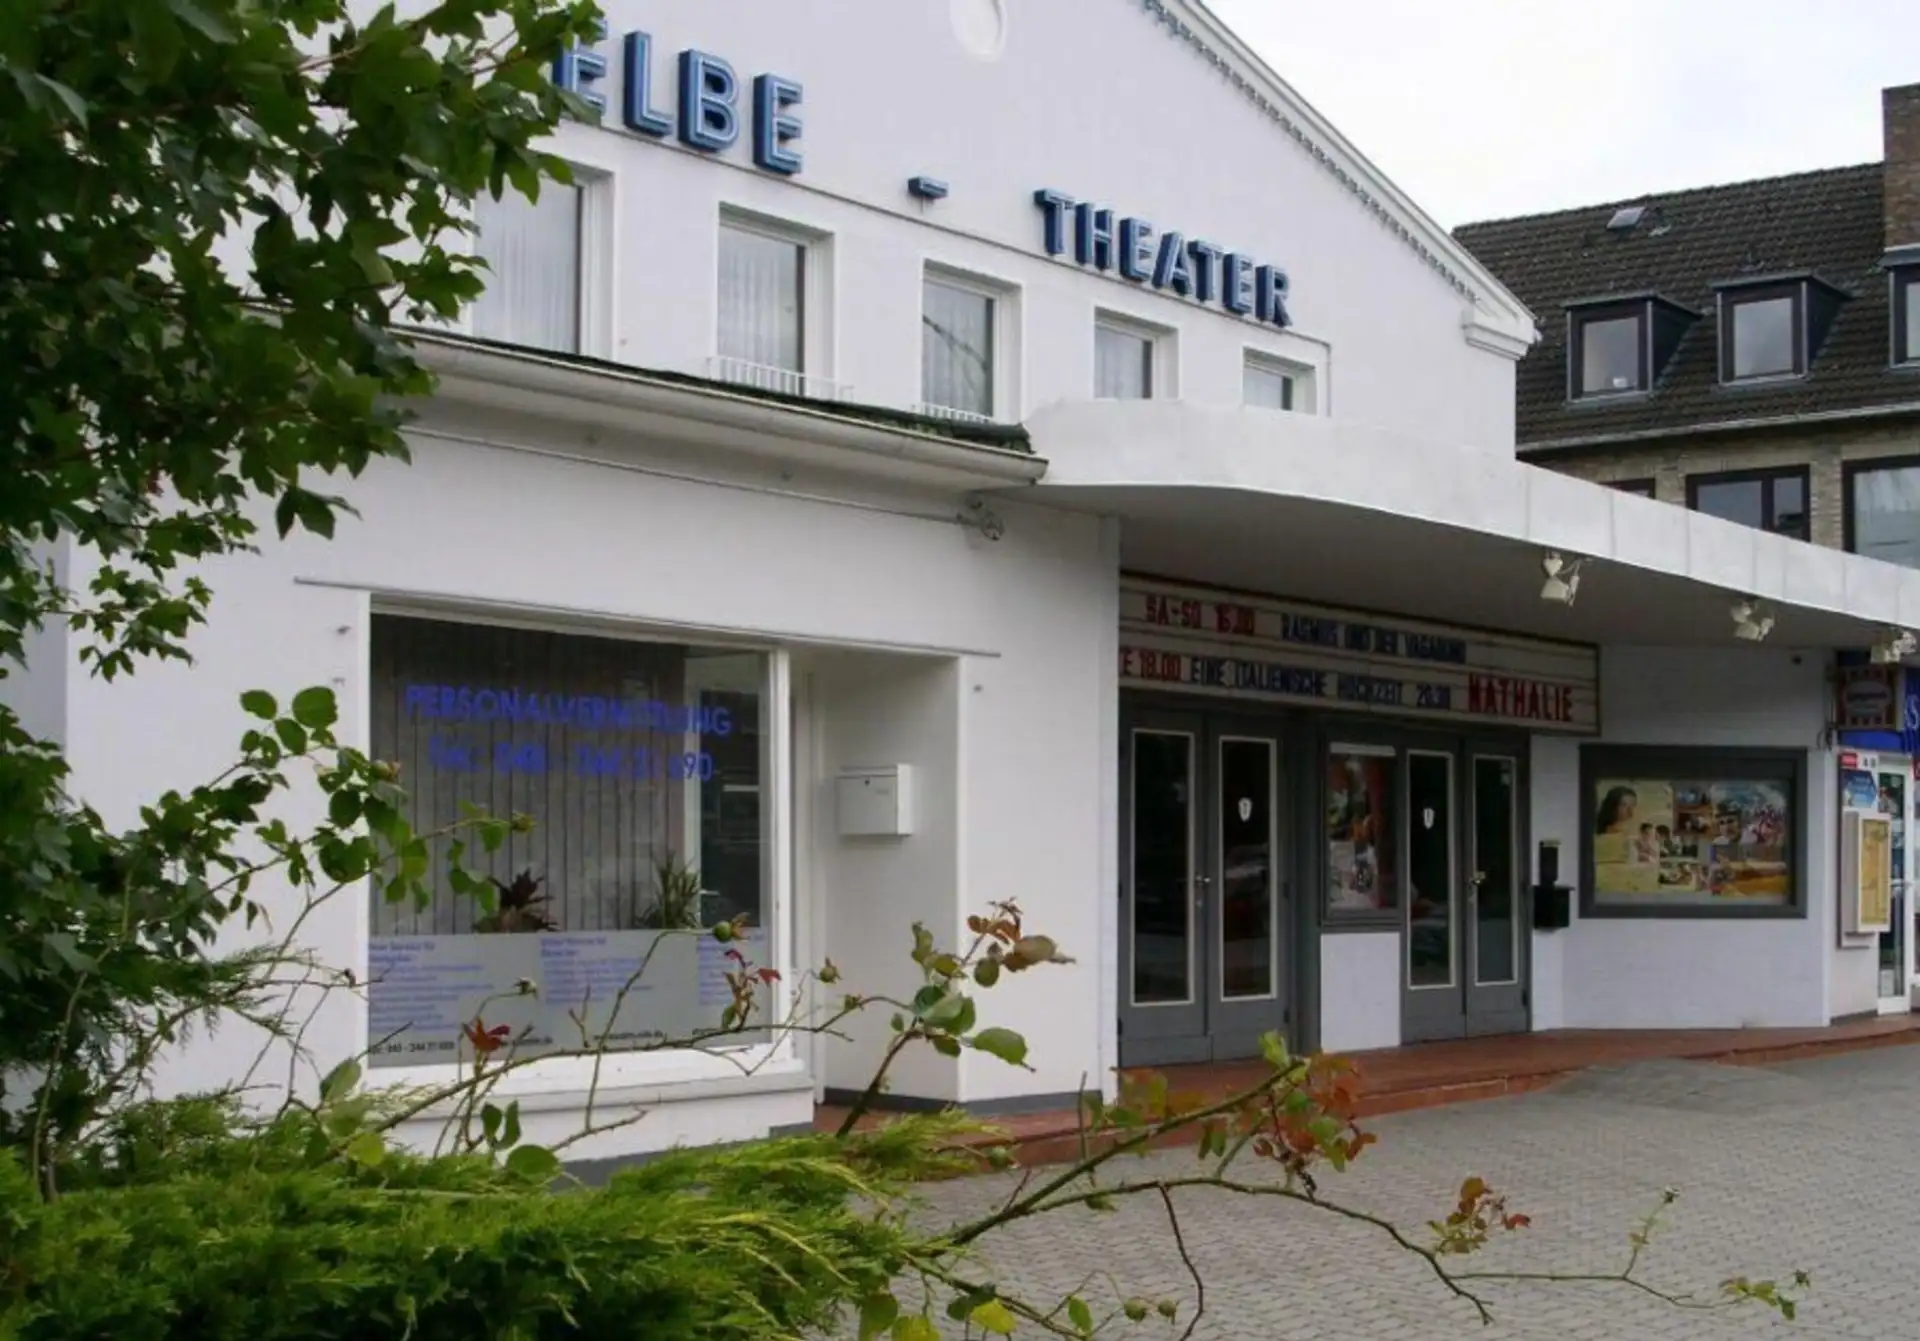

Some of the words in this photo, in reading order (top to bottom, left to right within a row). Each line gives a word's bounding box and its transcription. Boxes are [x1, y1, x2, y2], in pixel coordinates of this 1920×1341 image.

[552, 20, 803, 175] ELBE
[1034, 188, 1293, 328] THEATER
[1467, 672, 1574, 722] NATHALIE
